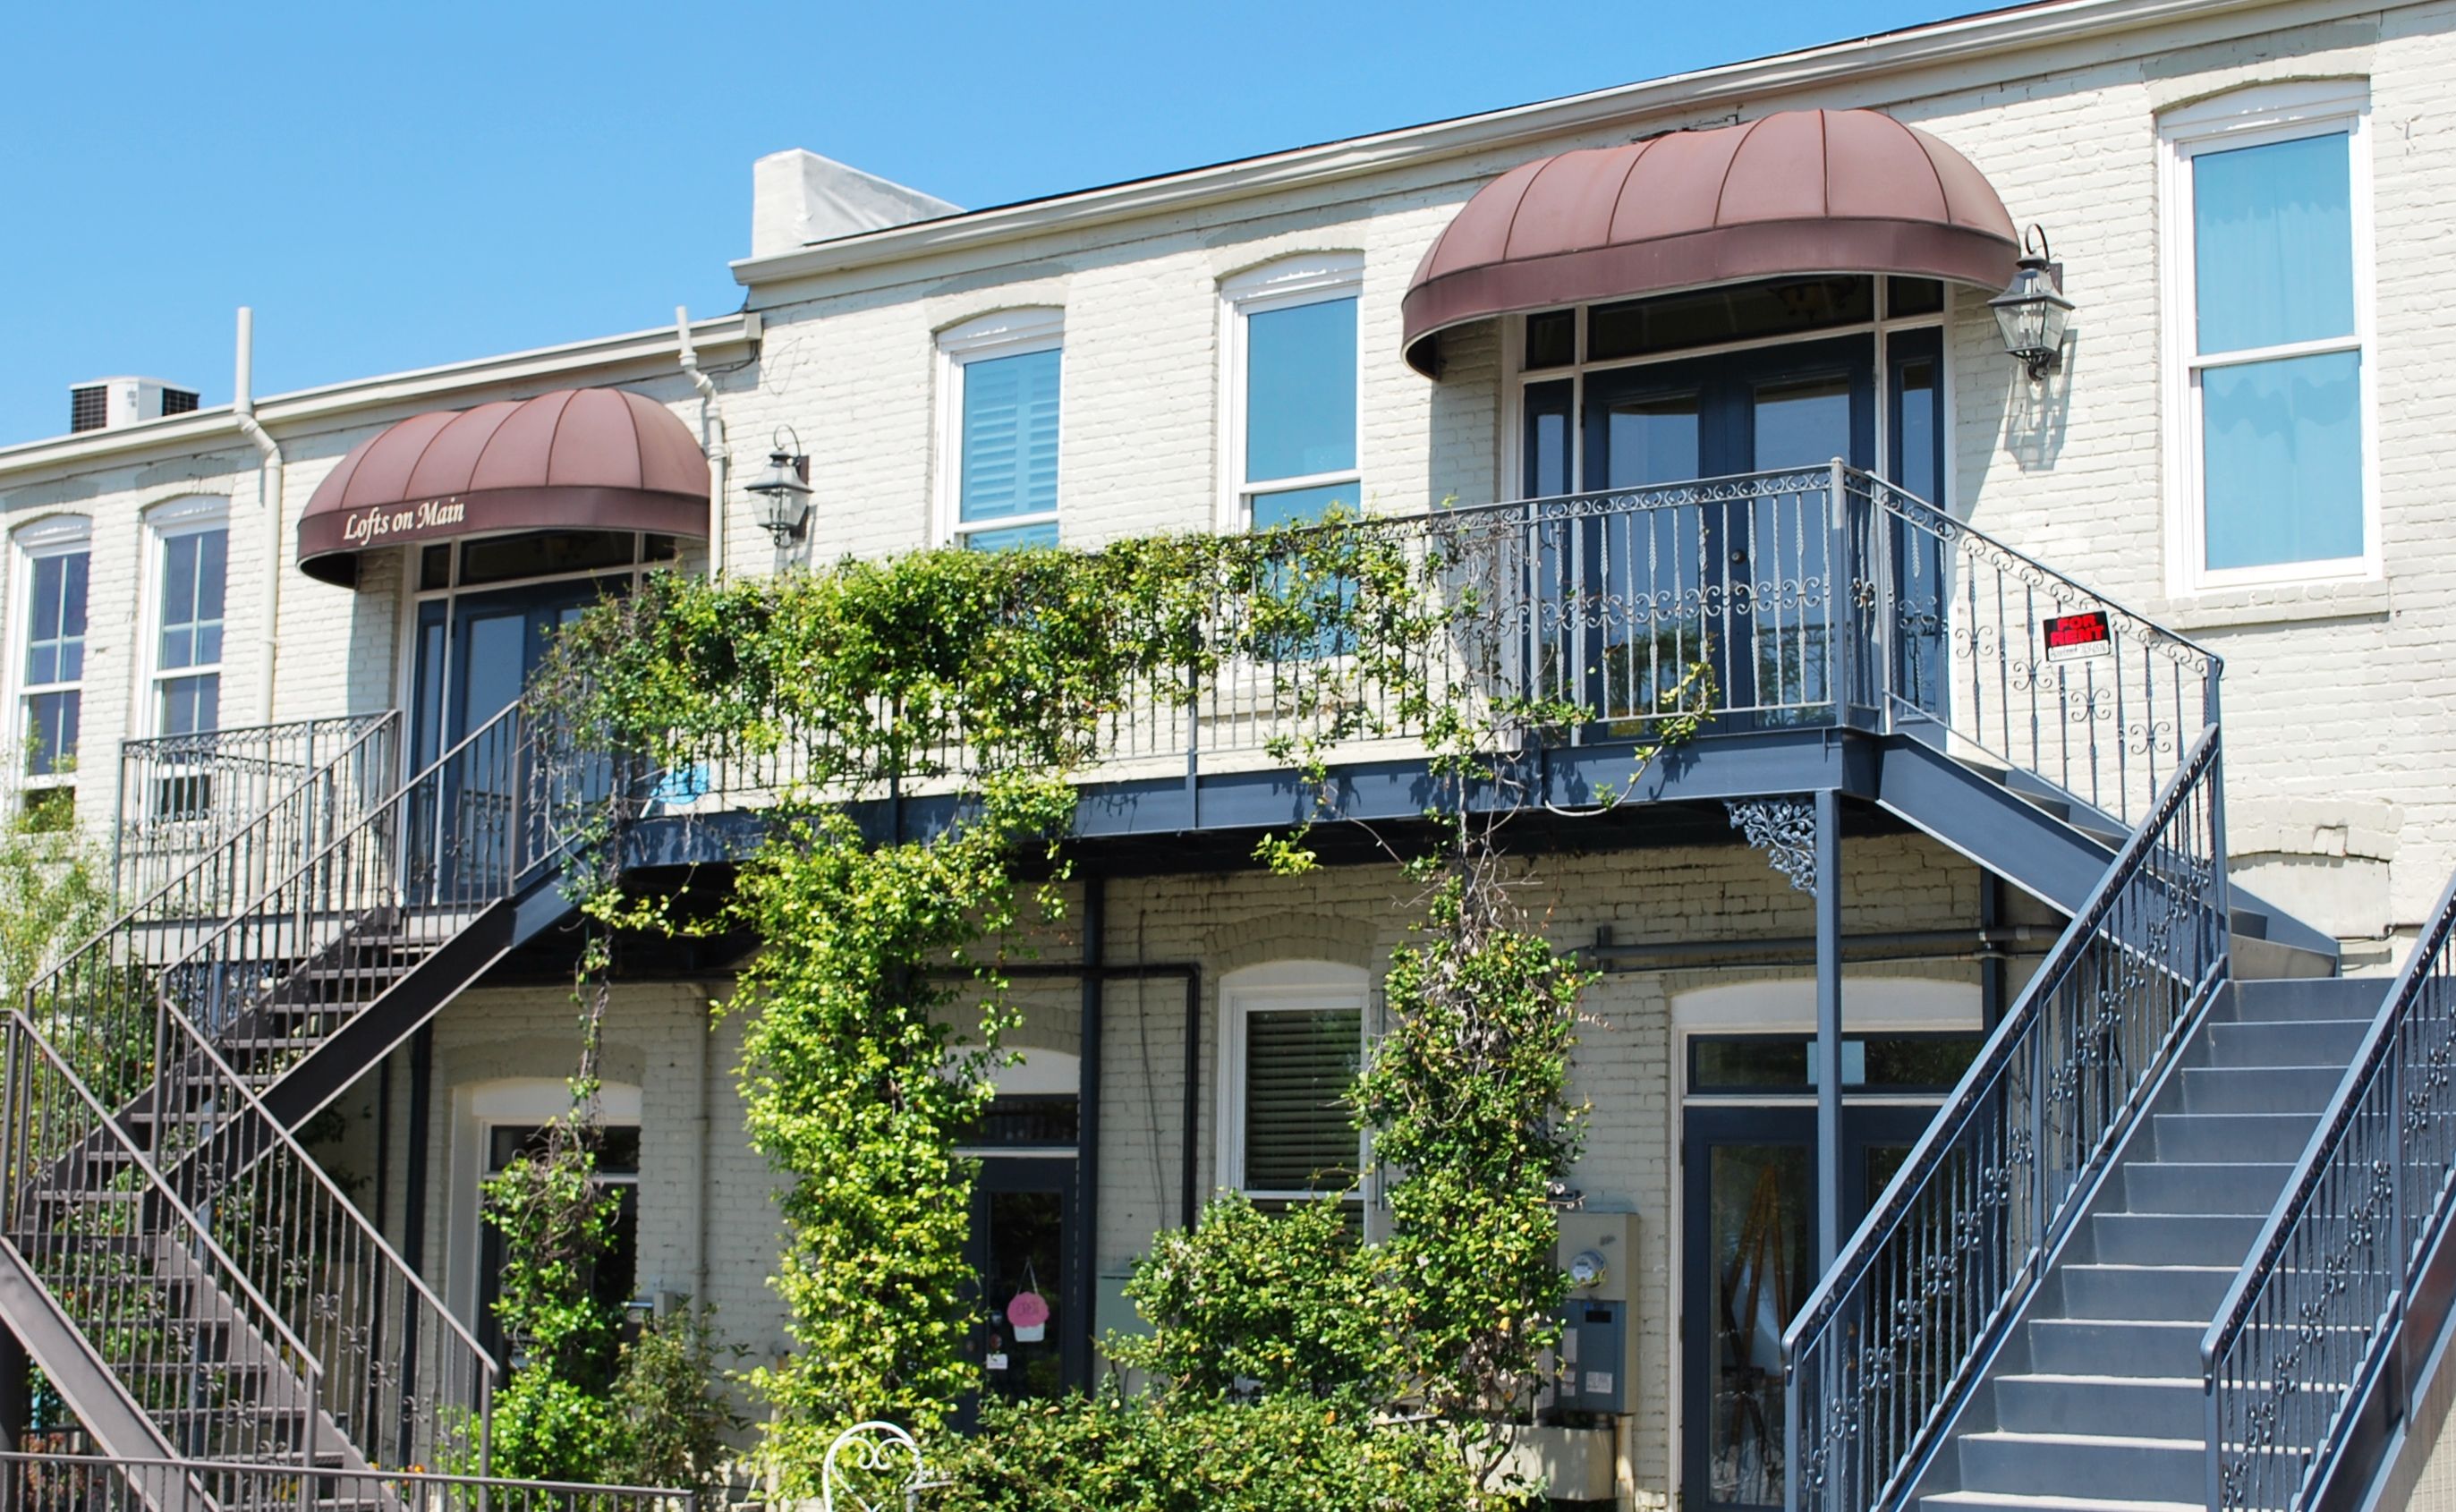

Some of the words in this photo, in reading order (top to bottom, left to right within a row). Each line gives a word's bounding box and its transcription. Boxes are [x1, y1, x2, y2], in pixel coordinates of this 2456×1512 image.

[344, 506, 390, 546] Lofts
[392, 510, 414, 532] on
[417, 497, 464, 530] Main
[2057, 614, 2096, 632] FOR
[2051, 624, 2104, 647] RENT
